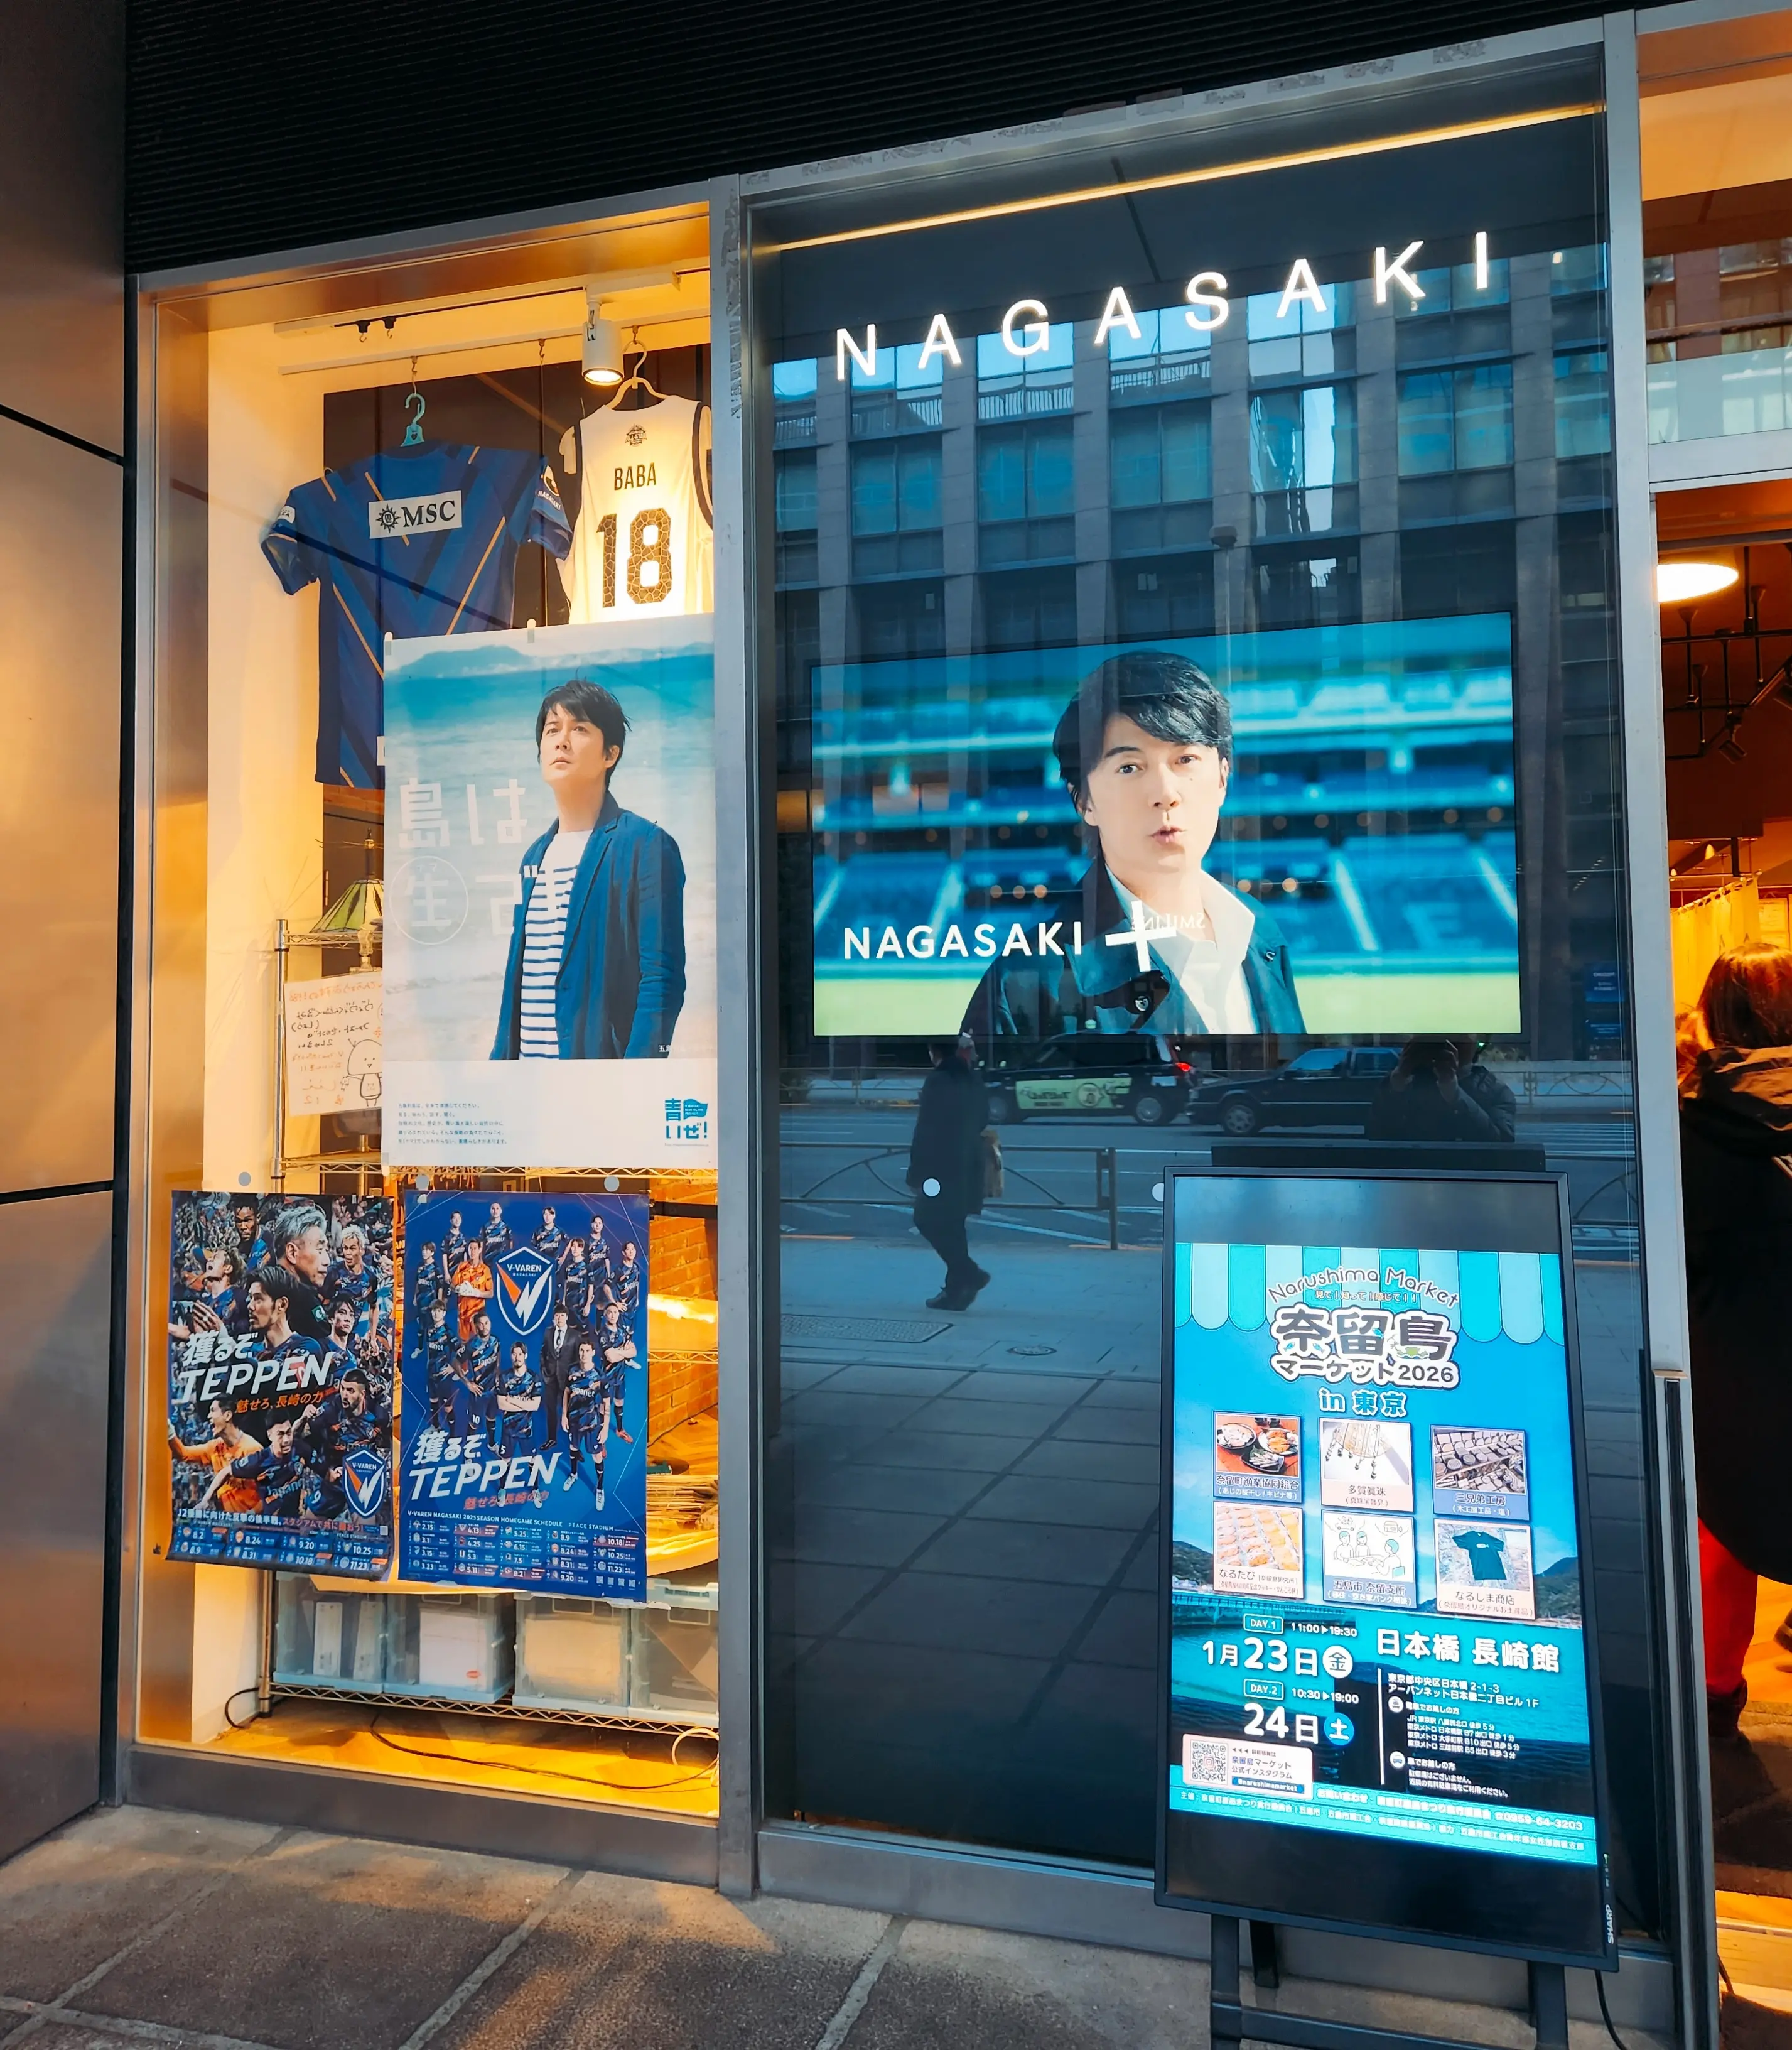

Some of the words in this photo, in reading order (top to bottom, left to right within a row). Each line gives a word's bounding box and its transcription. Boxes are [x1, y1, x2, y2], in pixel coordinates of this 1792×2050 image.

[836, 231, 1488, 381] NAGASAKI
[614, 462, 657, 491] BABA
[401, 501, 455, 528] MSC
[596, 507, 672, 608] 18
[844, 921, 1081, 959] NAGASAKI
[507, 1263, 542, 1273] V-VAREN
[1268, 1267, 1379, 1303] Narushima
[1385, 1266, 1459, 1308] Market
[1275, 1308, 1452, 1360] 奈留島
[182, 1331, 259, 1366] 獲るぞ
[171, 1352, 336, 1406] TEPPEN
[235, 1392, 324, 1414] 魅せろ、長崎の力
[1319, 1389, 1345, 1411] in
[1352, 1389, 1407, 1416] 東京
[413, 1430, 487, 1465] 獲るぞ
[352, 1462, 377, 1470] V-VAREN
[409, 1452, 563, 1500] TEPPEN
[1455, 1493, 1506, 1506] 三兄弟工房
[534, 1519, 563, 1527] SCHEDULE
[1219, 1568, 1256, 1581] なるたび
[1333, 1580, 1363, 1592] 五島市
[1455, 1590, 1516, 1606] なるしま商店
[1328, 1652, 1347, 1672] 金
[1377, 1627, 1460, 1663] 日本橋
[1471, 1637, 1560, 1673] 長崎館
[1470, 1681, 1500, 1693] 2-1-3
[1525, 1698, 1539, 1708] 1F
[1244, 1703, 1319, 1744] 24日
[1329, 1718, 1350, 1740] 土
[1232, 1756, 1292, 1770] 奈留島マーケット
[1232, 1765, 1292, 1779] 公式インスタグラム
[1605, 1903, 1614, 1944] SHARP
